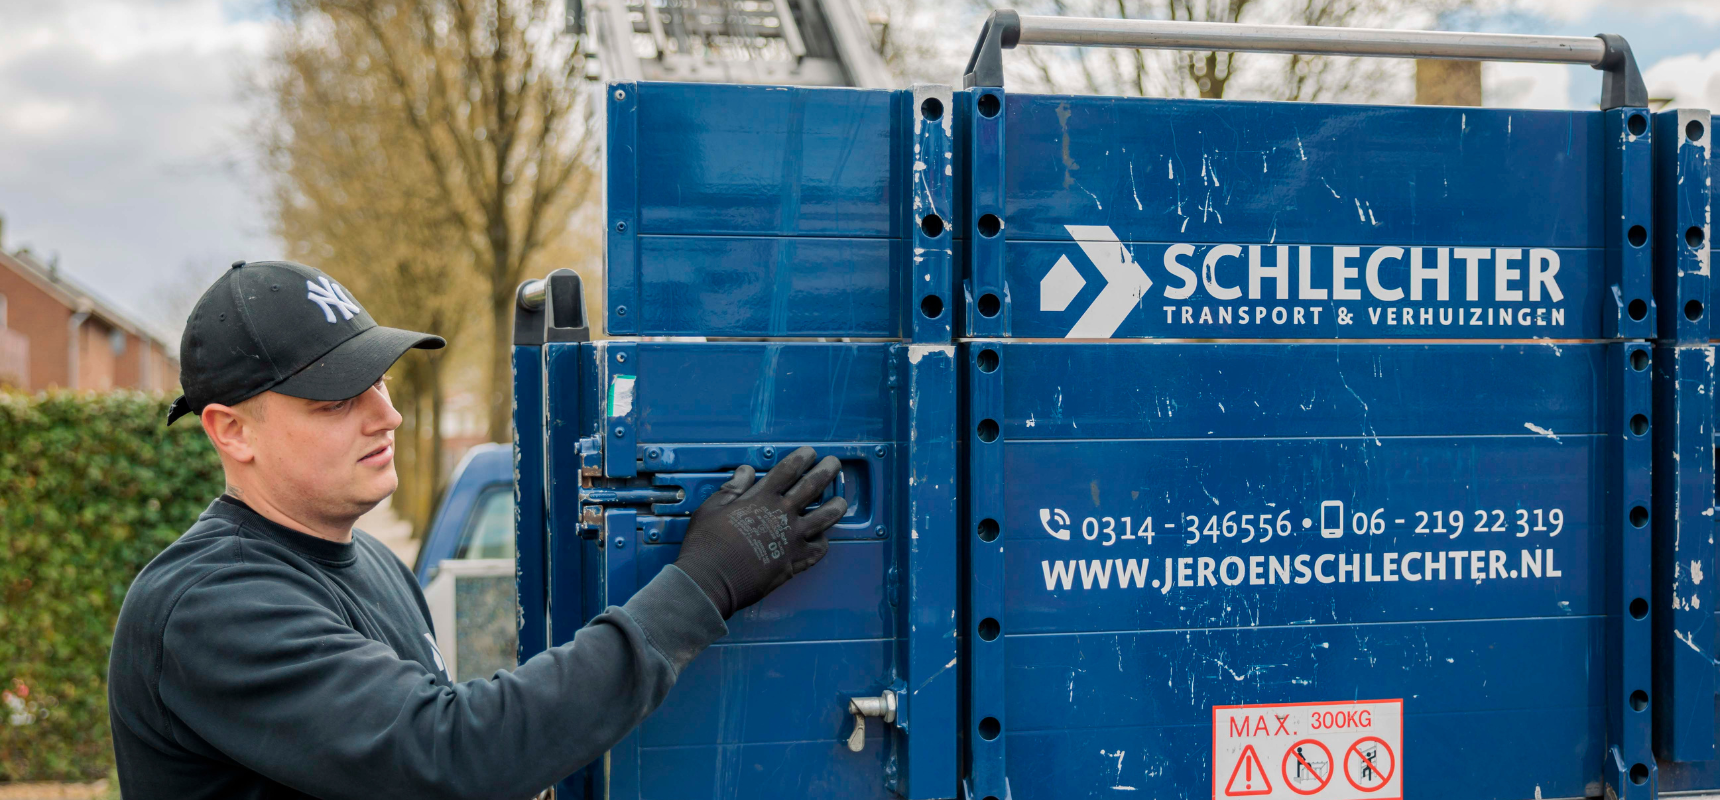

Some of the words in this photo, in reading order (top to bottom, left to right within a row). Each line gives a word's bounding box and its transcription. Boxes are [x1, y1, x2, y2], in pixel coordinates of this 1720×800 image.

[1163, 243, 1564, 302] SCHLECHTER
[1163, 306, 1323, 325] TRANSPORT
[1337, 306, 1354, 325] &
[1368, 307, 1565, 326] VERHUIZINGEN
[1082, 516, 1156, 546] 0314
[1186, 509, 1292, 545] 346556
[1352, 507, 1386, 536] 06
[1414, 510, 1464, 540] 219
[1473, 509, 1506, 533] 22
[1515, 508, 1564, 538] 319
[768, 541, 780, 559] 09
[1041, 548, 1562, 595] WWW.JEROENSCHLECHTER.NL
[1229, 714, 1298, 738] MAX.
[1310, 709, 1372, 730] 300KG
